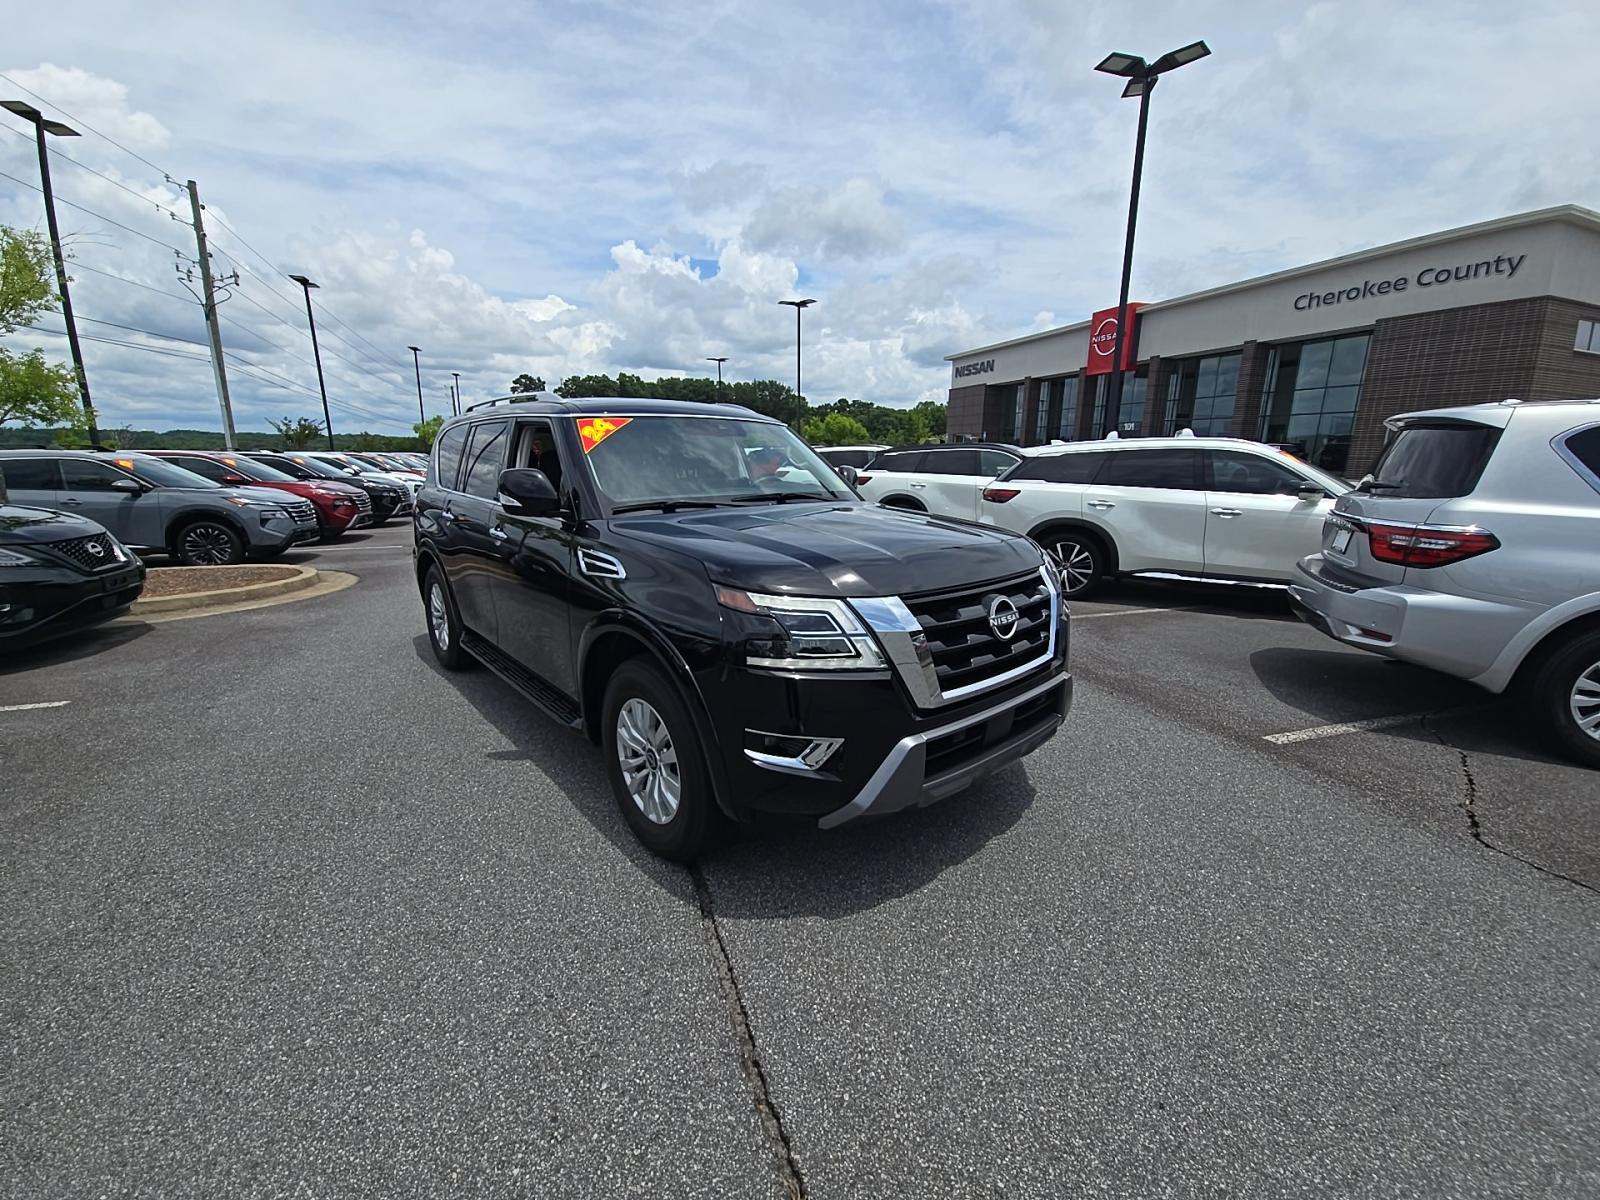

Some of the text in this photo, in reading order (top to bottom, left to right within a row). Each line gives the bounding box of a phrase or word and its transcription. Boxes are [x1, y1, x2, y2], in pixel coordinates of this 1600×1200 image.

[1294, 254, 1527, 311] Cherokee County
[1092, 332, 1117, 342] NISSA
[955, 359, 995, 378] NISSAN
[989, 611, 1020, 627] NISSAN
